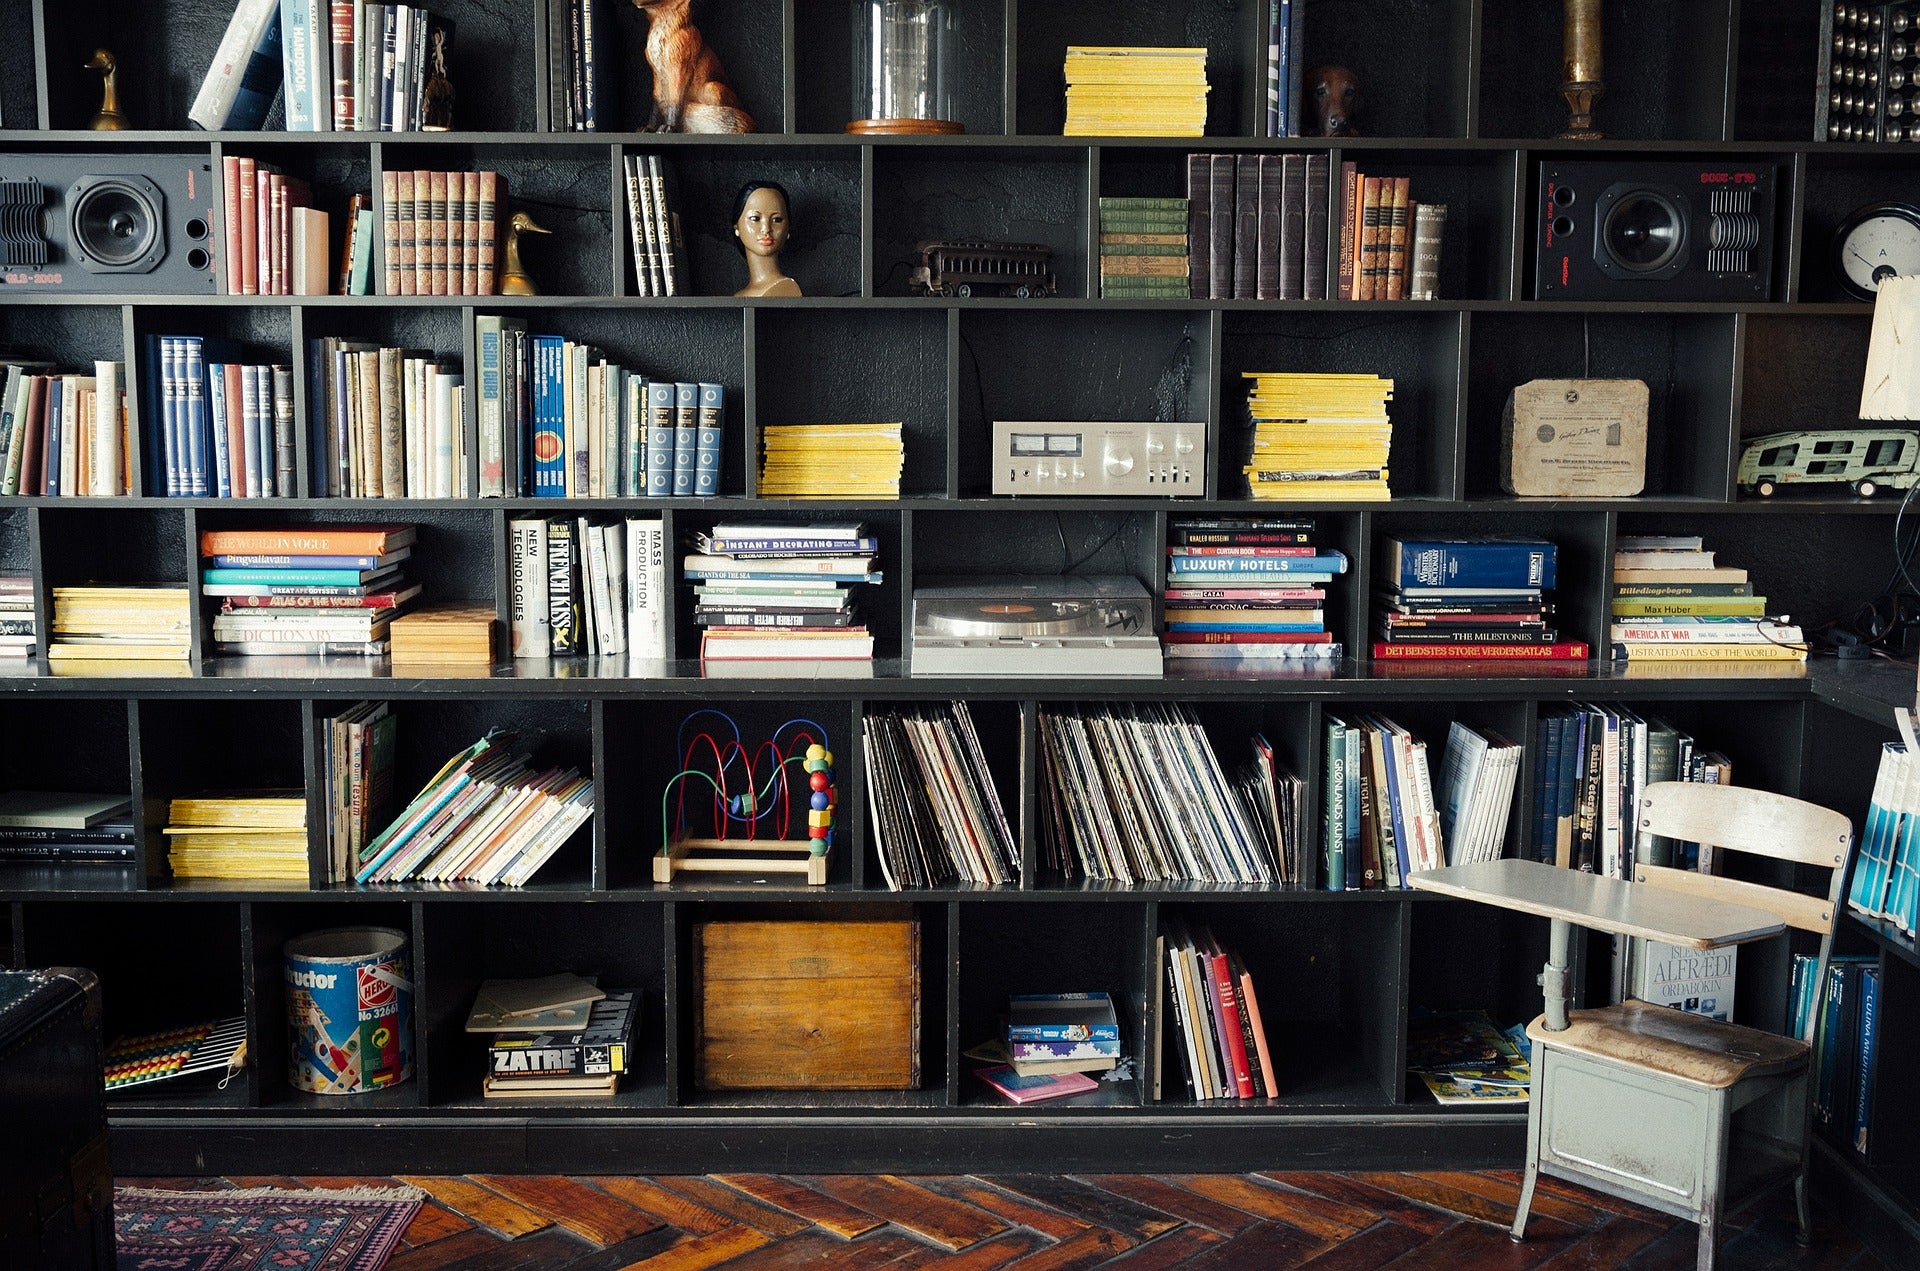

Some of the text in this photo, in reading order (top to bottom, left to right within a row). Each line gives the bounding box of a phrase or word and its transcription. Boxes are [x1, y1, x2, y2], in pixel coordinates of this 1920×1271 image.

[293, 27, 306, 93] HANDBOOK
[1349, 212, 1355, 220] TO
[635, 220, 644, 244] SKIP
[648, 220, 656, 244] SKIP
[661, 220, 670, 244] SKIP
[1420, 254, 1438, 263] 1904
[1879, 248, 1887, 257] A
[505, 338, 513, 376] POSSESSIONS
[640, 386, 648, 409] American
[278, 539, 290, 549] IN
[291, 539, 330, 549] VOGUE
[529, 529, 538, 557] NEW
[652, 530, 662, 566] MASS
[726, 539, 833, 550] INSTANT DECORATING
[1189, 534, 1208, 543] KHALED
[1208, 534, 1230, 543] HOSSEINI
[1238, 534, 1260, 542] THOUSAND
[1260, 534, 1280, 542] SPLENDID
[637, 530, 648, 609] PRODUCTION
[697, 570, 718, 579] GIANTS
[728, 571, 738, 579] THE
[738, 571, 751, 579] SEA
[1182, 559, 1235, 571] LUXURY
[1240, 559, 1289, 571] HOTELS
[1431, 548, 1439, 586] DICTIONARY
[513, 529, 524, 622] TECHNOLOGIES
[549, 539, 571, 629] FRENCH KISS
[308, 587, 339, 595] ODYSSEY
[270, 596, 364, 607] ATLAS OF THE WORLD
[1644, 605, 1691, 614] Max Huber
[725, 613, 749, 625] SAHARA
[753, 614, 775, 625] WEYER
[243, 629, 331, 642] DICTIONARY
[1453, 632, 1477, 641] THE
[1478, 632, 1532, 641] MILESTONES
[1624, 629, 1690, 640] AMERICA AT WAR
[1385, 646, 1552, 657] DET BEDSTES STORE VERDENSATLAS
[1629, 645, 1778, 657] USTRATED ATLAS OF THE WORLD
[1417, 756, 1434, 813] REFLECTIONS
[1582, 743, 1601, 841] Saint Petersburg
[352, 783, 361, 816] lesum
[1359, 775, 1371, 817] FUGLAR
[1333, 759, 1344, 855] GRØNLANDS KUNST
[364, 980, 391, 999] HERO
[358, 1011, 371, 1022] No
[1243, 1027, 1254, 1049] SKIP
[494, 1048, 577, 1073] ZATRE
[1857, 995, 1874, 1123] CULINA MEDITERRANEA
